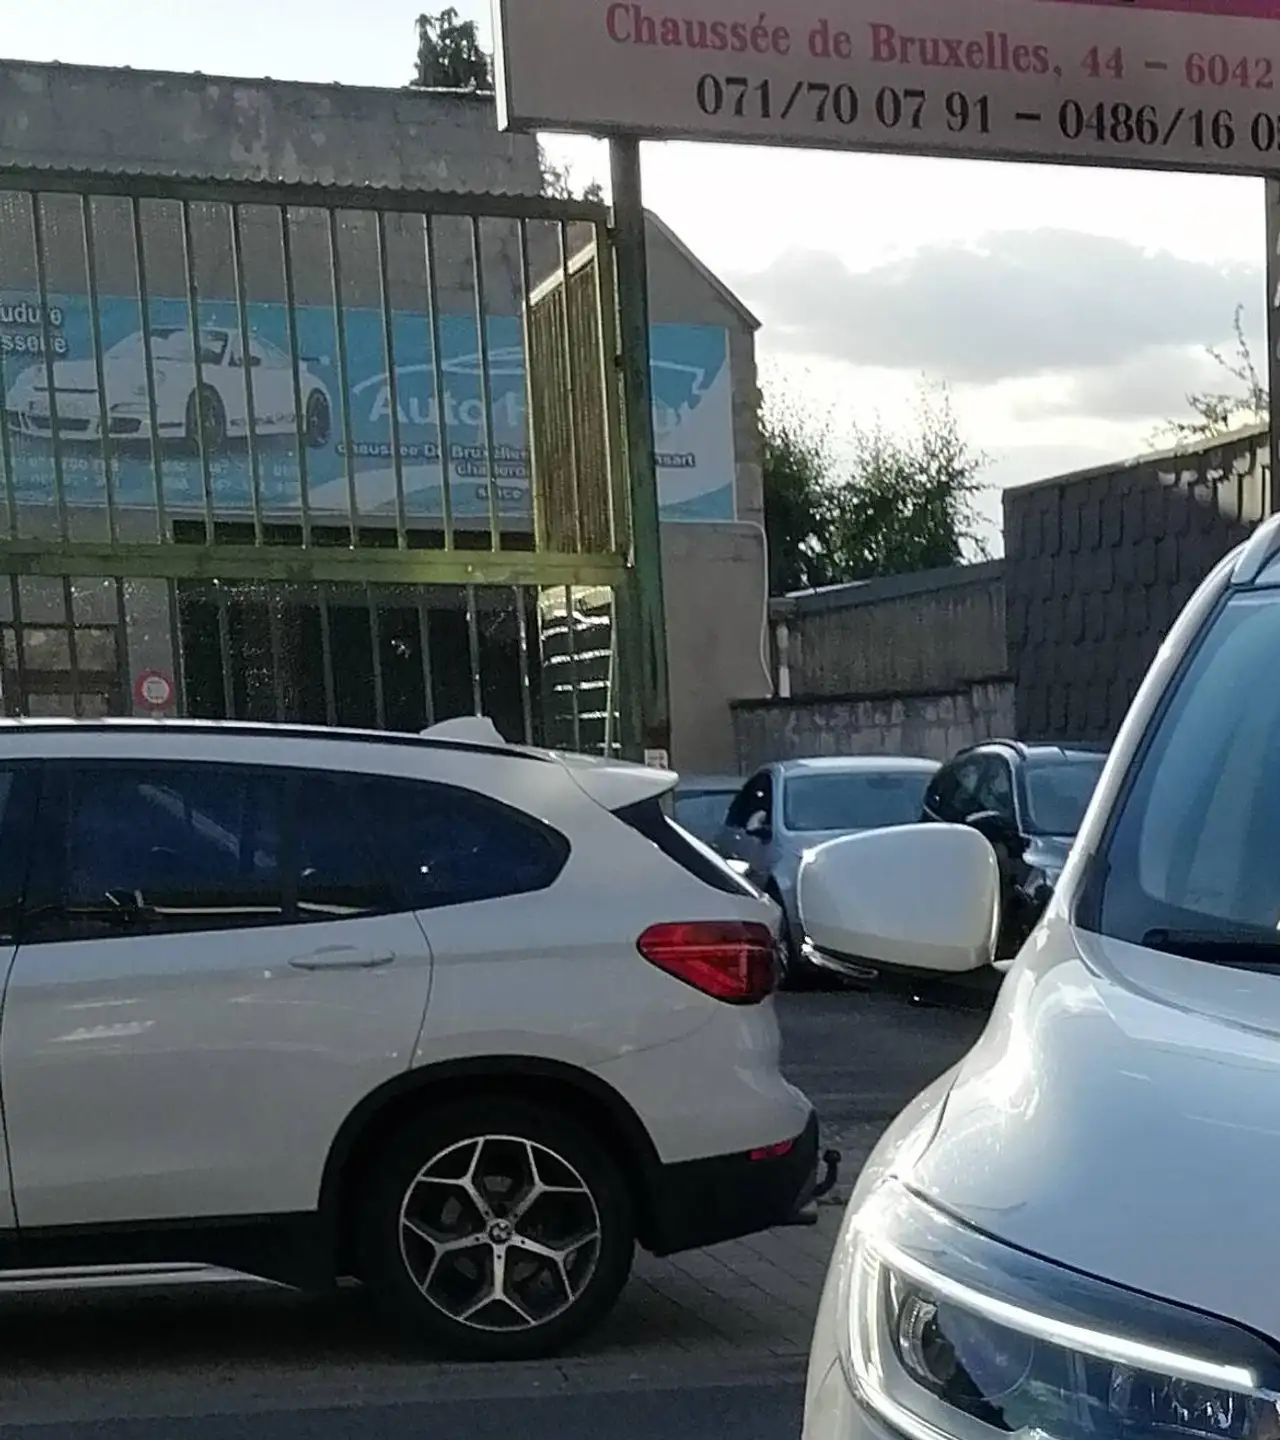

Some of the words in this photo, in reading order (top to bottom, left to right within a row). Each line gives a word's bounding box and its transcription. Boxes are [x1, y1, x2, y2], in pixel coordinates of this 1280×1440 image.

[606, 4, 791, 56] Chaussée
[808, 18, 852, 60] de
[868, 22, 1062, 79] Bruxelles,
[1080, 45, 1125, 80] 44
[1184, 51, 1275, 91] 6042
[696, 72, 857, 124] 071/70
[875, 87, 925, 131] 07
[946, 93, 992, 135] 91
[1059, 98, 1234, 150] 0486/16
